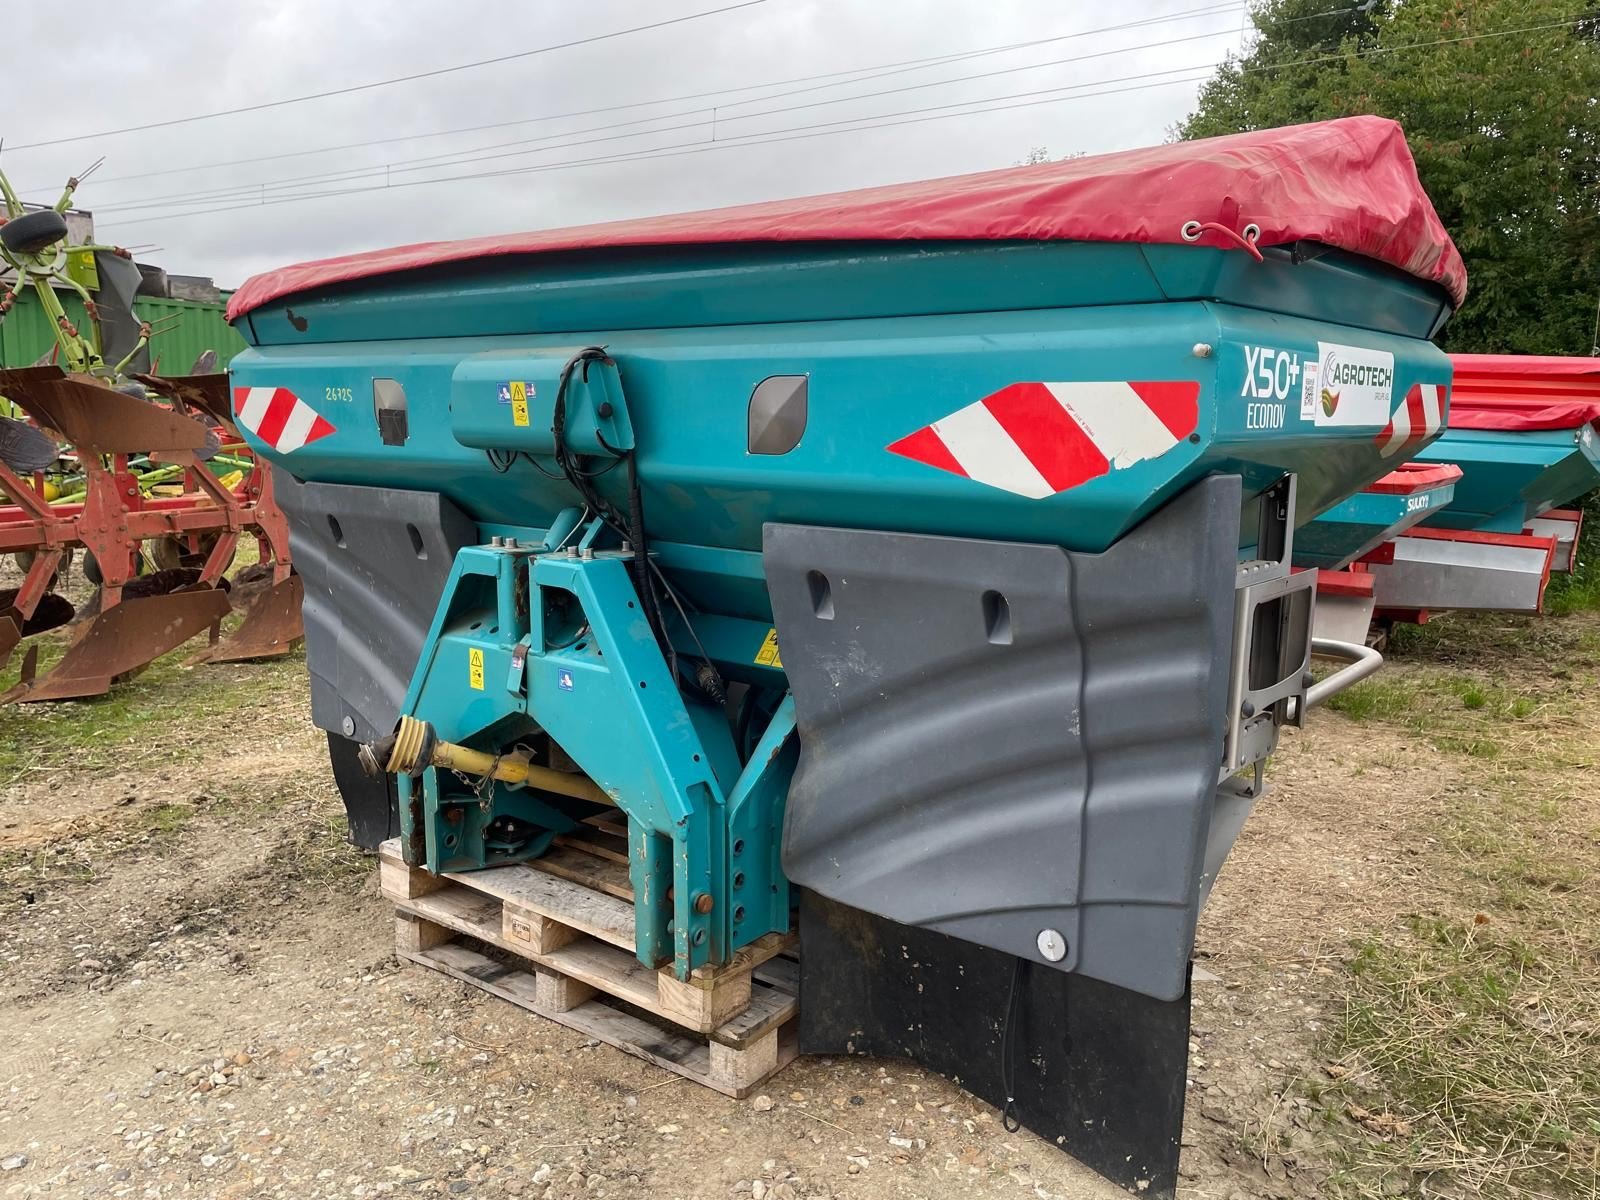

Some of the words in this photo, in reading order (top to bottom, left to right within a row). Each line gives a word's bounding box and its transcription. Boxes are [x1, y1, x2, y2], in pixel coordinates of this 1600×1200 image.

[1241, 345, 1300, 400] X50+
[1332, 362, 1393, 388] AGROTECH
[325, 387, 353, 402] 26725
